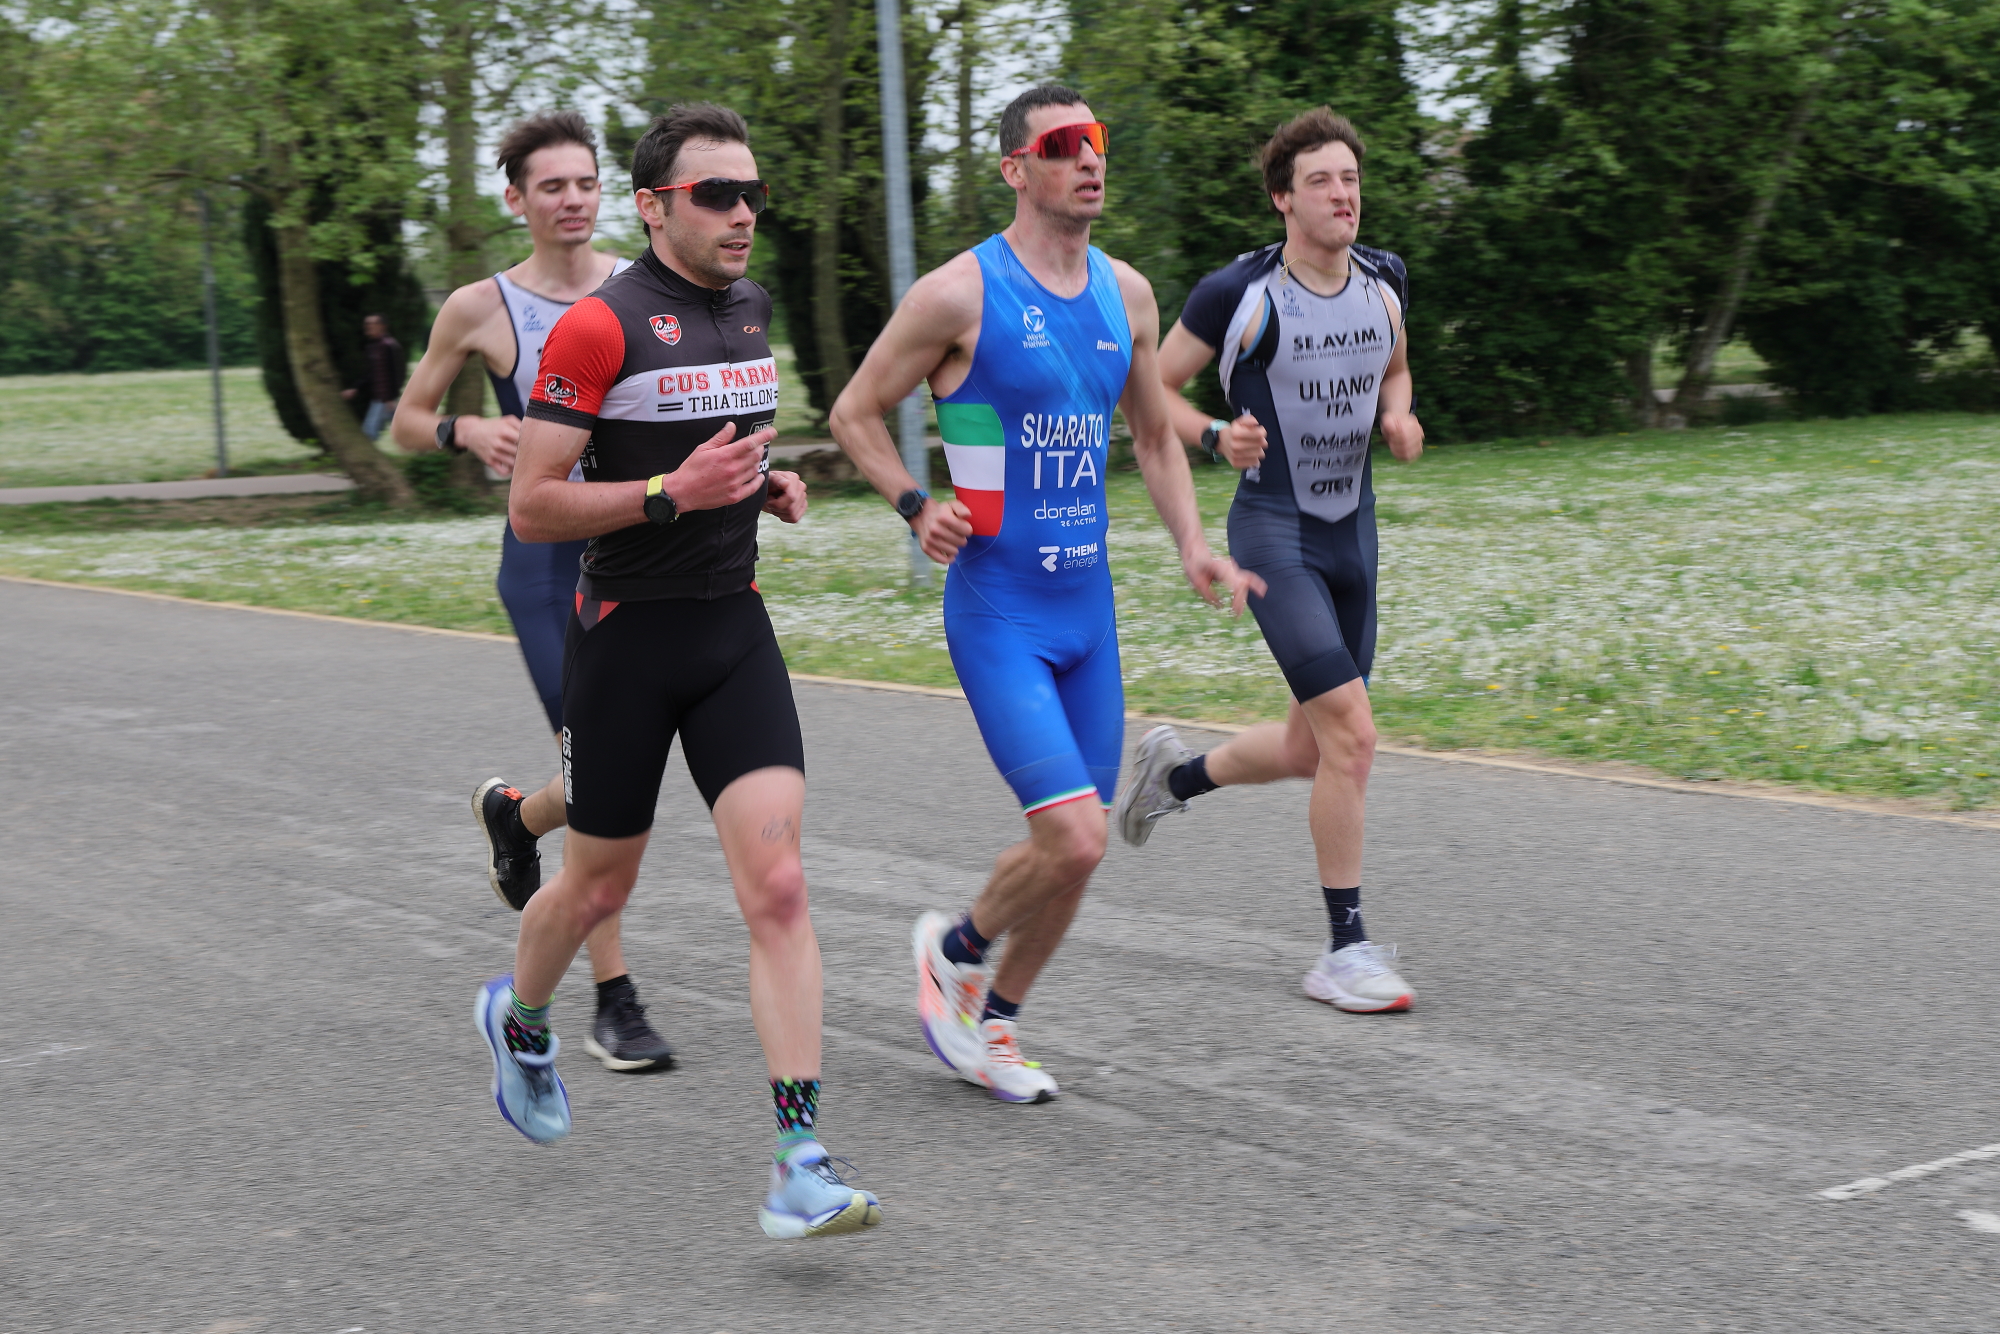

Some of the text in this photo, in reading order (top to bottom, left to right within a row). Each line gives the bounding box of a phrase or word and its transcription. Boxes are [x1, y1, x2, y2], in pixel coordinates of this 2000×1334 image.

[658, 371, 711, 396] CUS
[1299, 372, 1374, 402] ULIANO
[688, 388, 773, 412] TRIATHLON
[1326, 401, 1353, 418] ITA
[1021, 412, 1104, 448] SUARATO
[1033, 450, 1097, 489] ITA
[1034, 497, 1096, 519] dorelan
[1063, 554, 1098, 569] energia
[1064, 542, 1098, 558] THEMA
[563, 726, 572, 758] CUS
